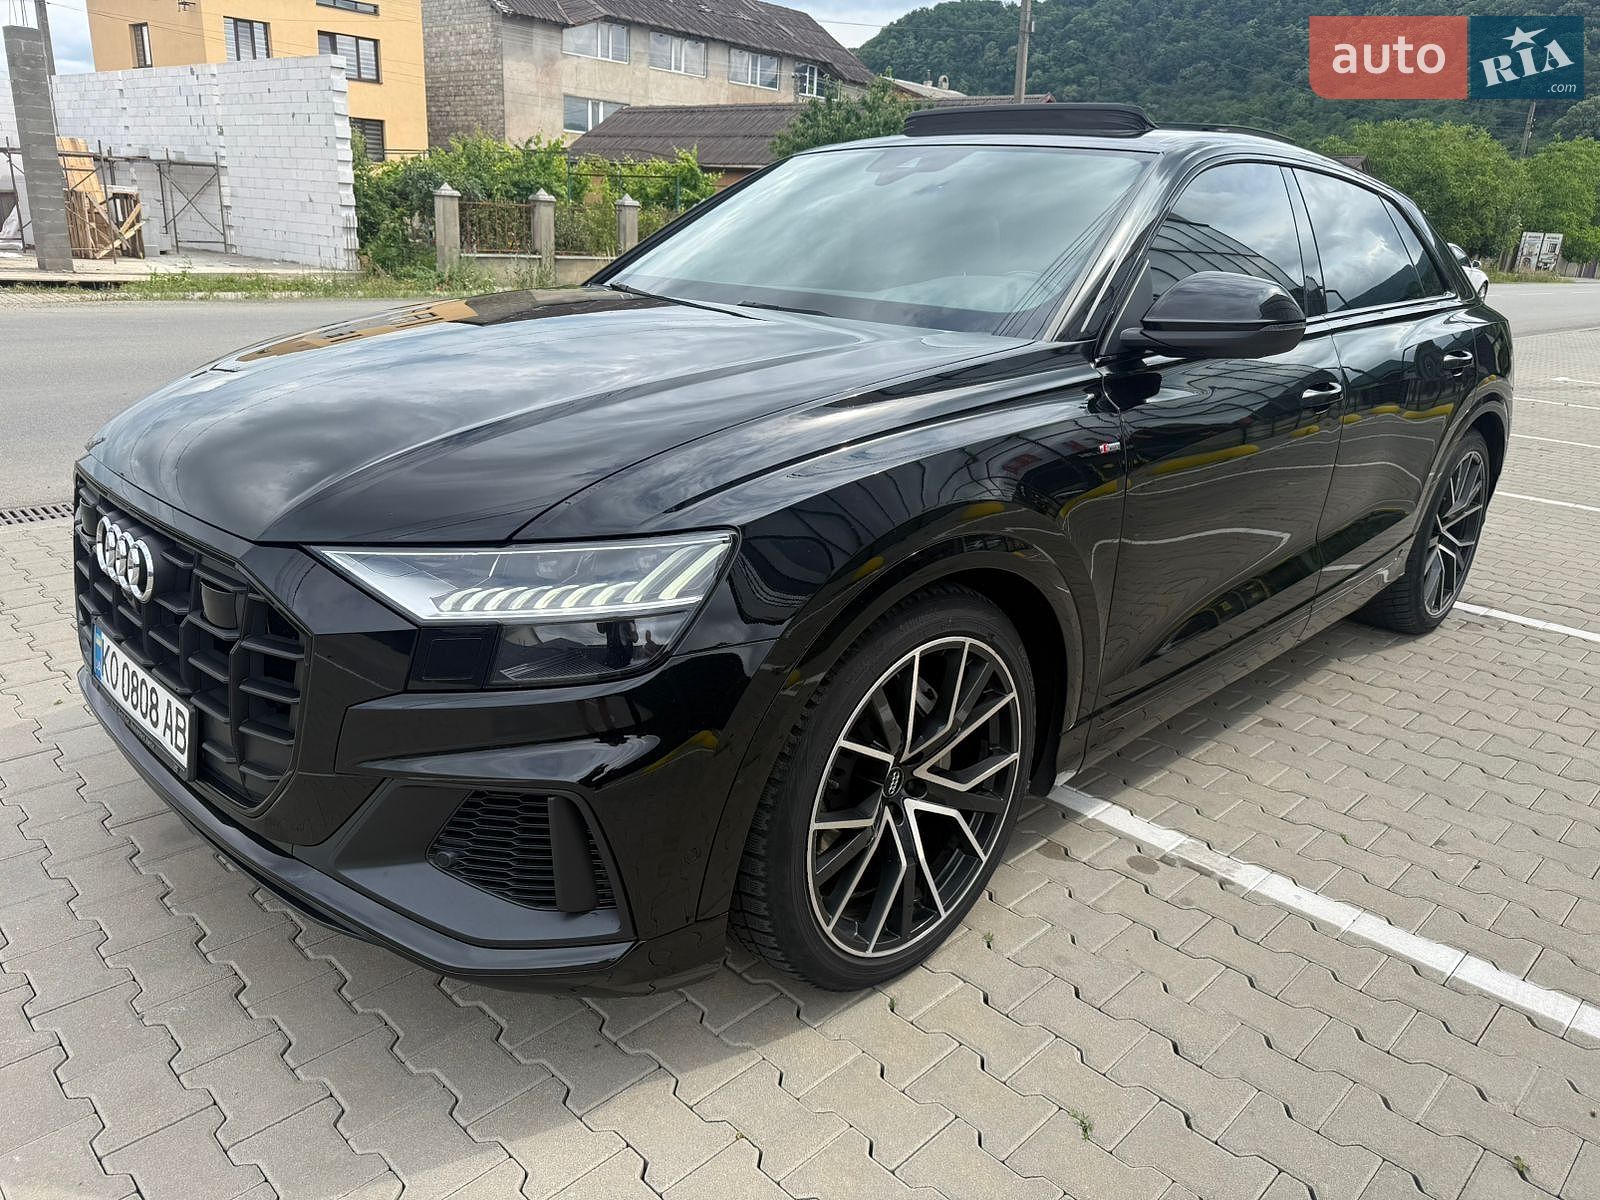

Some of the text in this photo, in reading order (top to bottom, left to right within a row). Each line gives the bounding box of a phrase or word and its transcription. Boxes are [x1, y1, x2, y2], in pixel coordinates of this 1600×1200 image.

[102, 645, 119, 690] KO
[122, 662, 159, 729] 0808
[163, 700, 187, 755] AB
